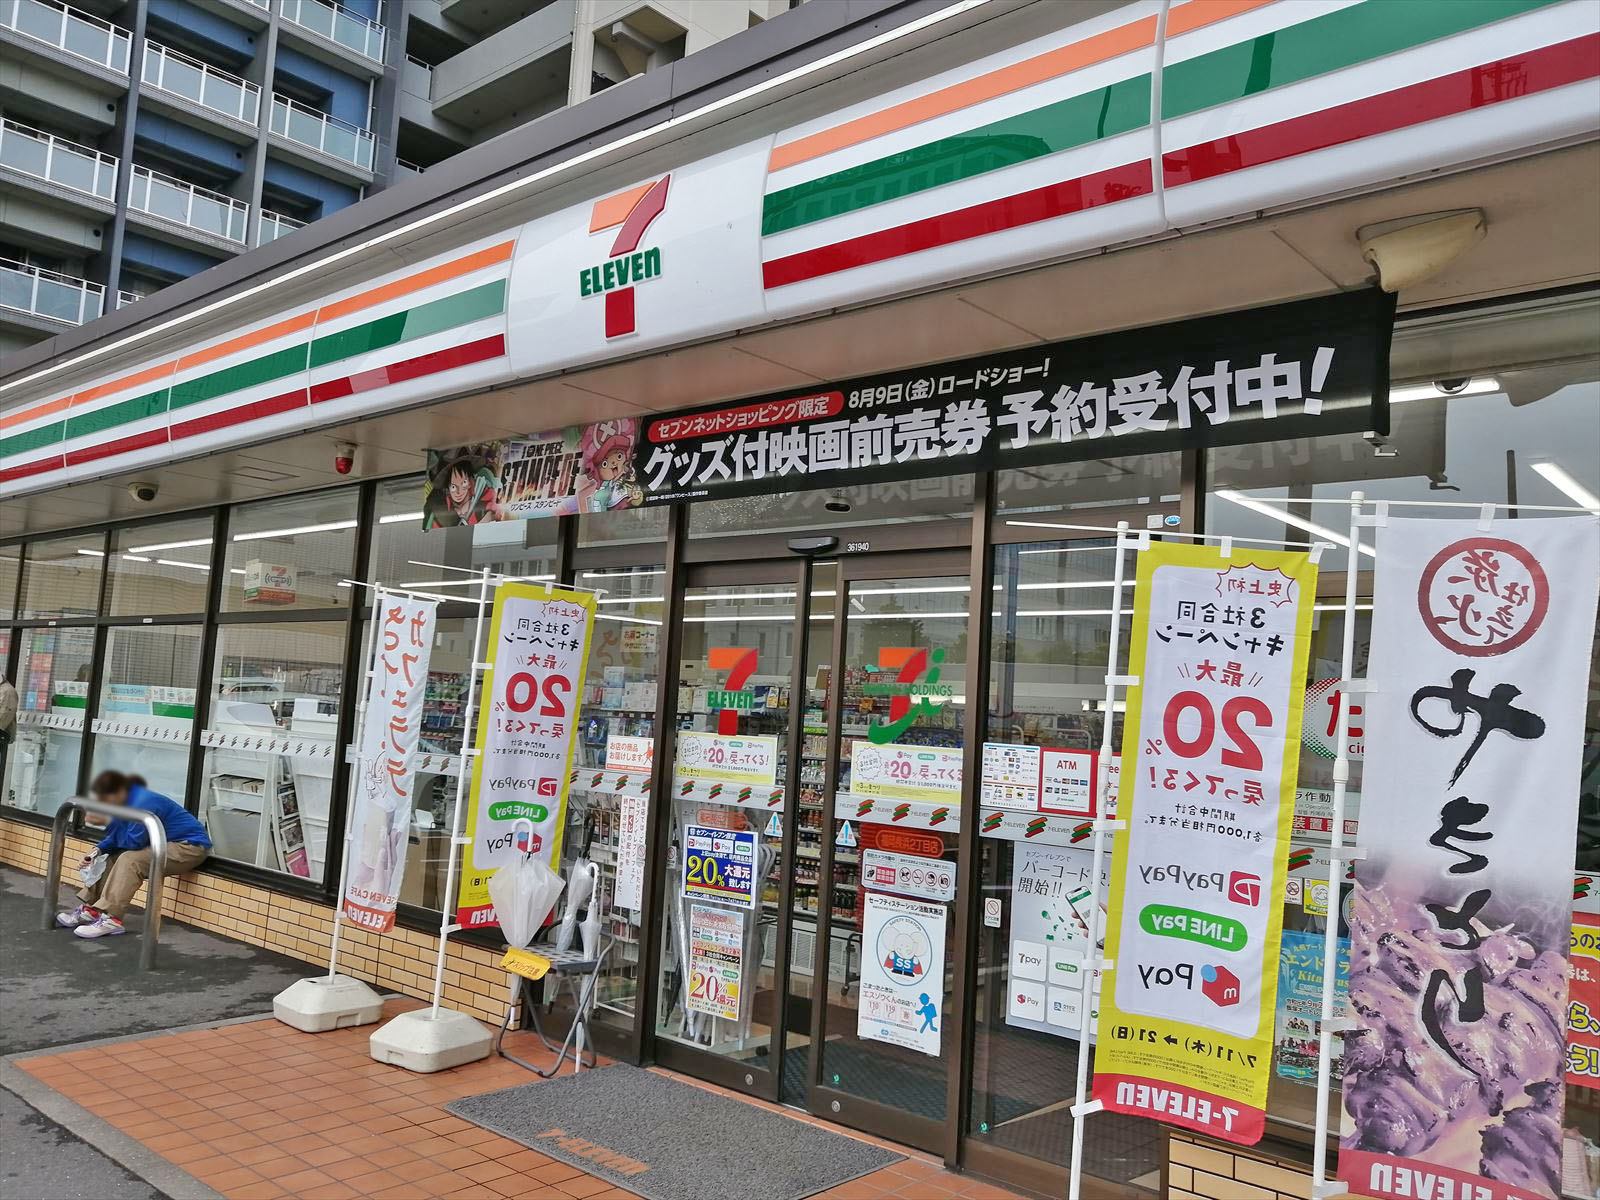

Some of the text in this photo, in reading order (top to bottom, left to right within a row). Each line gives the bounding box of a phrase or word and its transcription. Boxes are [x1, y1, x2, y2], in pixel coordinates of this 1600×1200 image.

[589, 174, 670, 338] 7
[644, 396, 991, 492] グッズ付映画前売券
[997, 347, 1335, 449] 予約受付中!
[658, 396, 829, 438] セブンネットショッピング限定
[497, 451, 583, 504] STAMPEDE
[847, 542, 869, 552] 361940
[707, 647, 758, 736] 7
[904, 683, 953, 697] OLDINGS
[1056, 760, 1078, 771] ATM
[895, 957, 912, 969] SS
[1018, 952, 1042, 966] 7pay
[1027, 996, 1039, 1007] Pay
